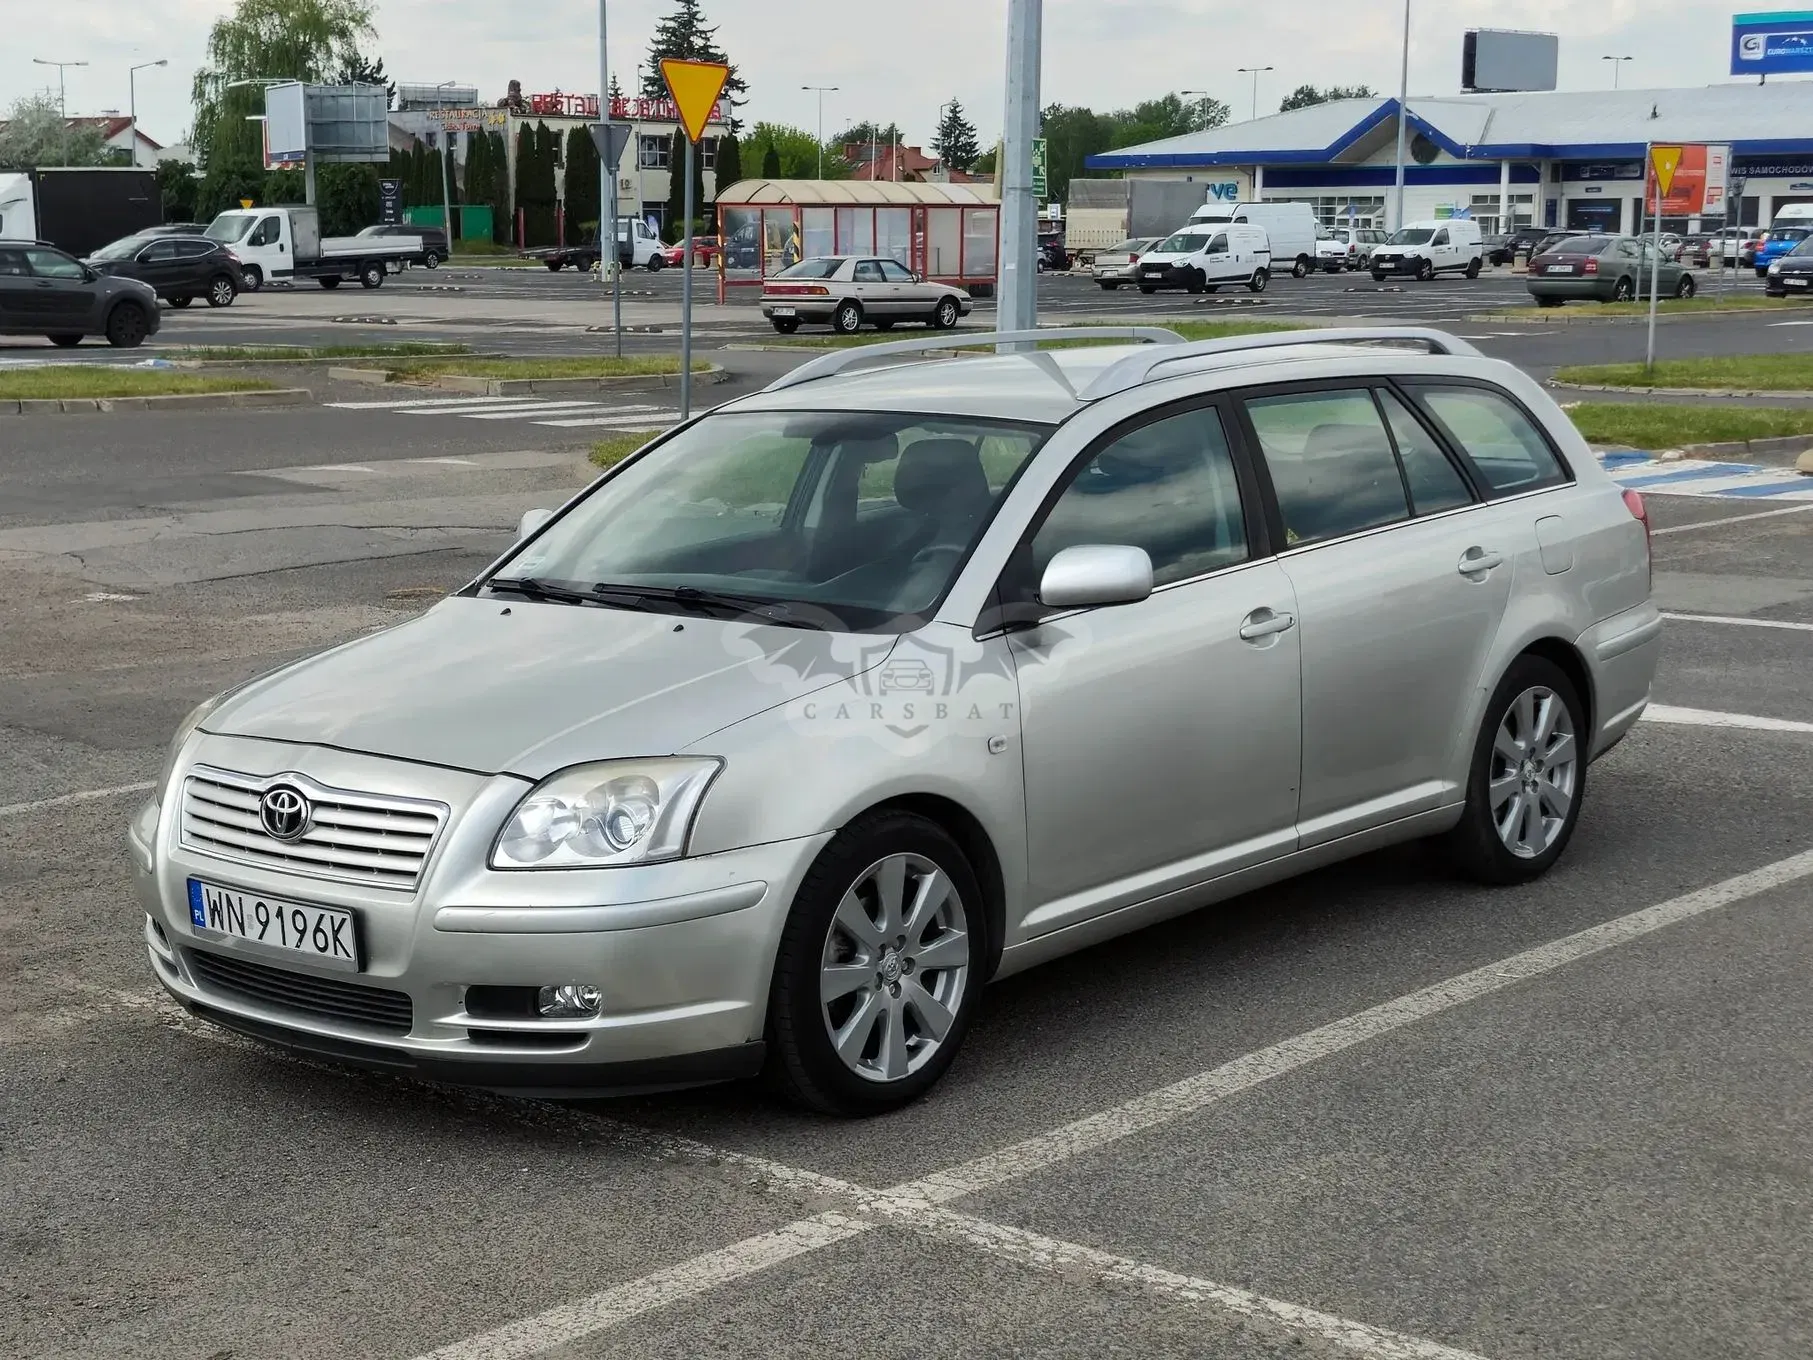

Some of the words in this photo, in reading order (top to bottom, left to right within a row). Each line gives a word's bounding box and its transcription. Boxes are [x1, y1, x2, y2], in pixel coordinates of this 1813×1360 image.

[1208, 182, 1239, 200] ve
[205, 888, 246, 937] WN
[254, 901, 352, 959] 9196K
